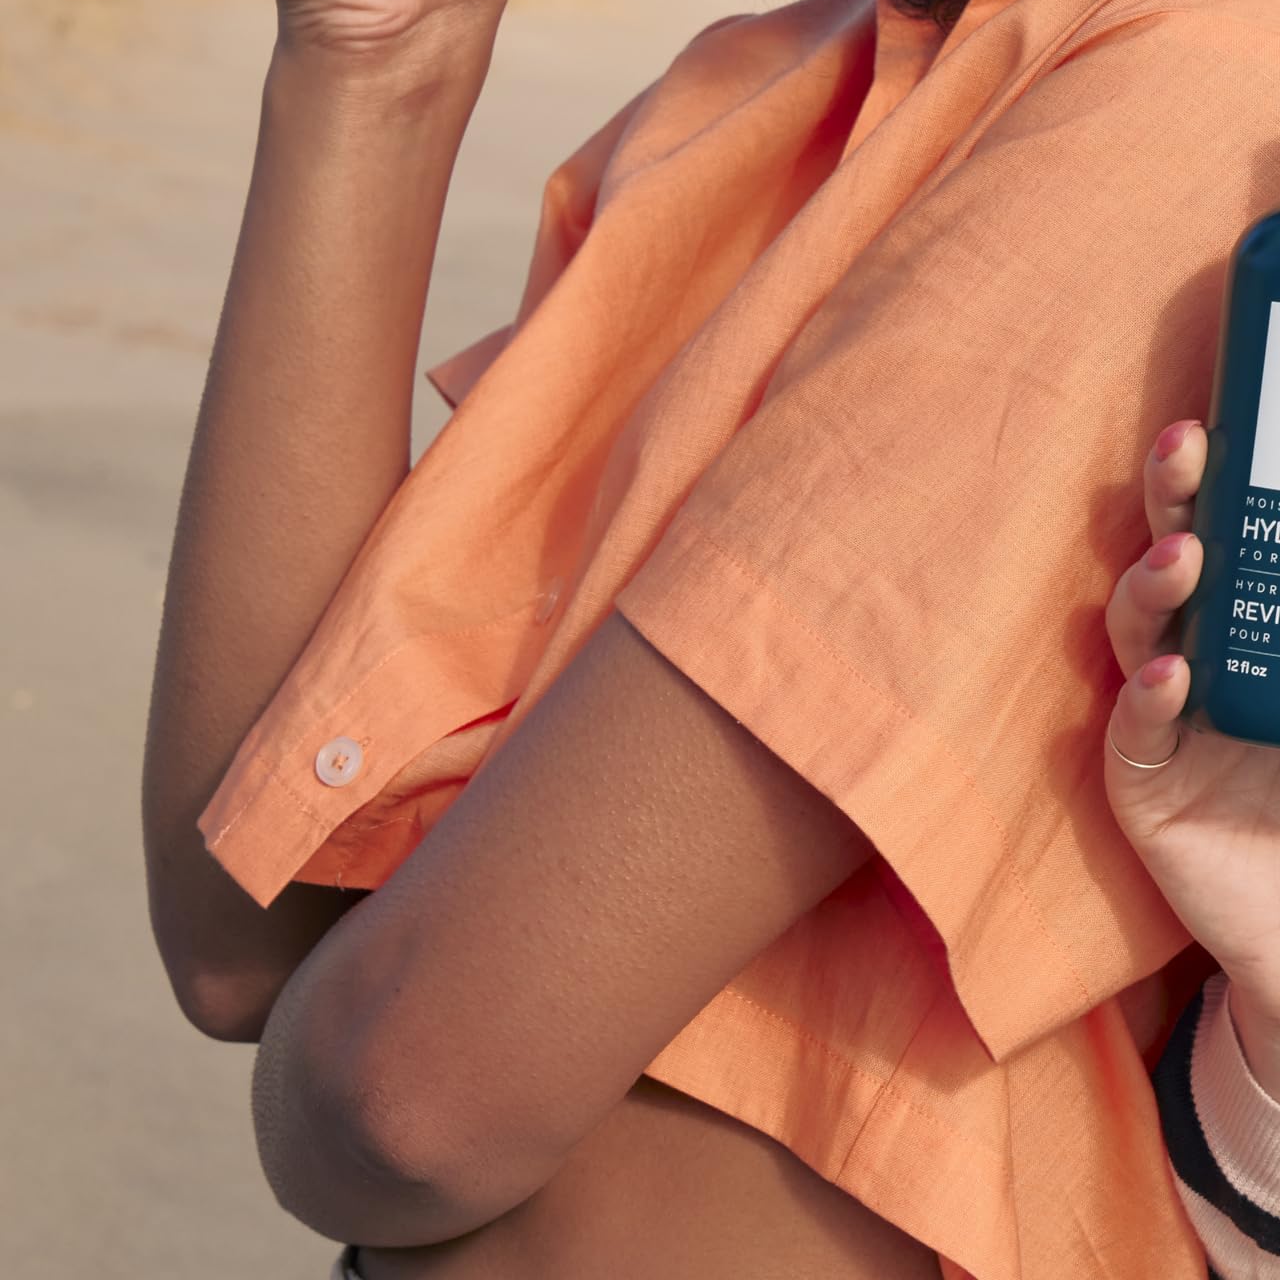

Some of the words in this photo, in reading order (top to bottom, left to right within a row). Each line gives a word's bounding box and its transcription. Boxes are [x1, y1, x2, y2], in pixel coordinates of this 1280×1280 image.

[1239, 547, 1279, 564] FOR
[1229, 627, 1271, 644] POUR
[1226, 658, 1239, 671] 12
[1240, 660, 1250, 674] fl
[1251, 665, 1268, 677] oz
